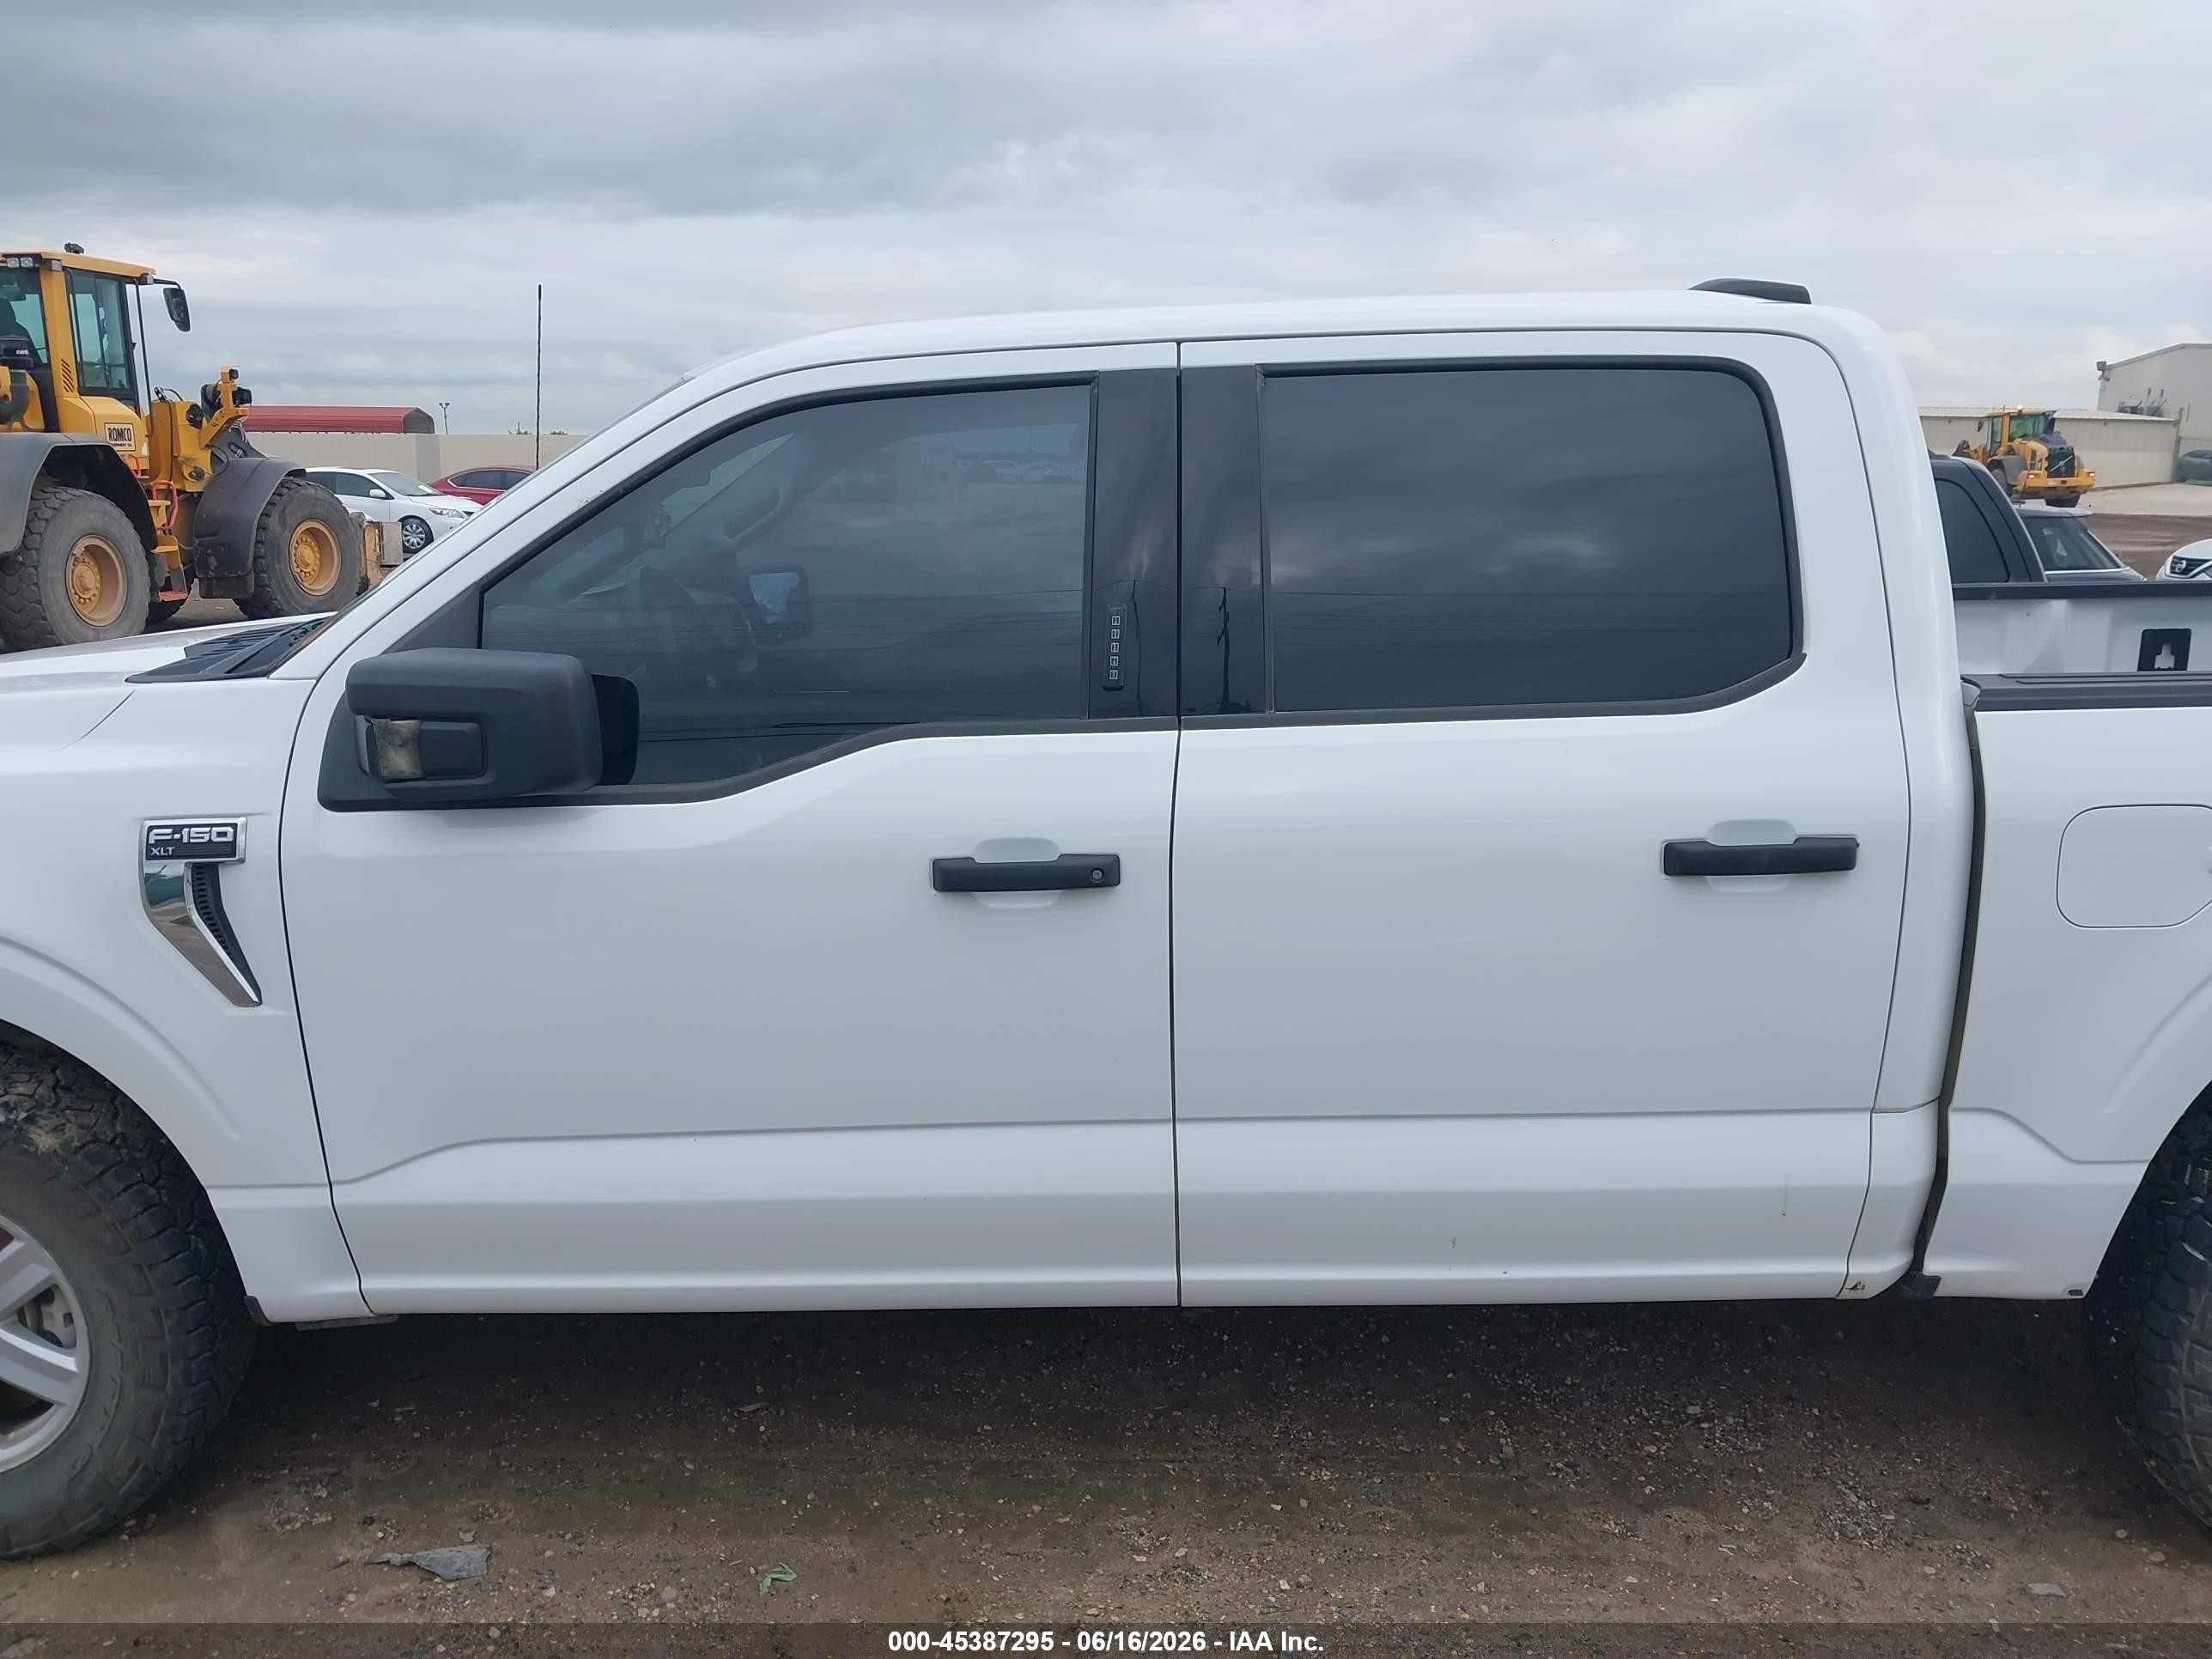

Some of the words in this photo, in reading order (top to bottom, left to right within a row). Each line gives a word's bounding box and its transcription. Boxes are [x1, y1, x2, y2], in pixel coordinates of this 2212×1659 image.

[107, 428, 132, 442] ROMCO
[148, 827, 234, 844] F-150
[150, 847, 174, 855] XLT
